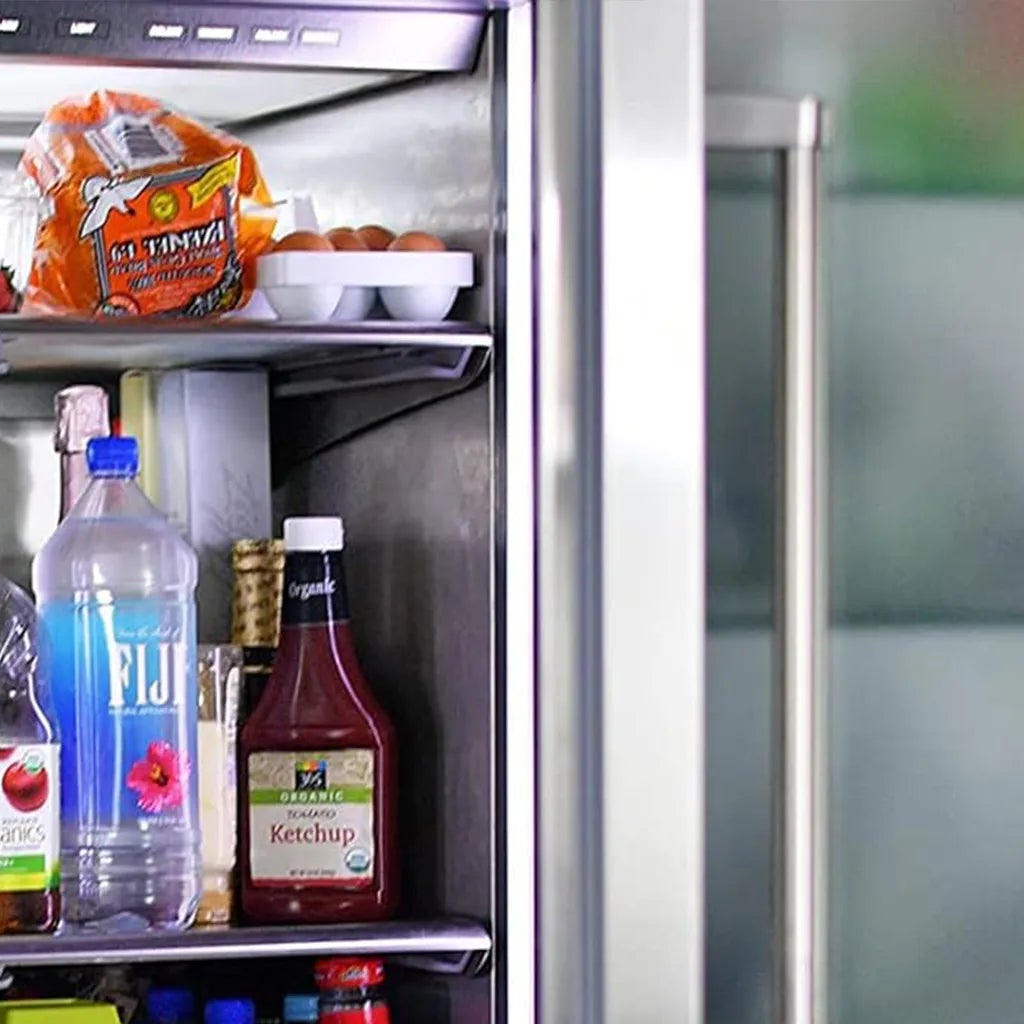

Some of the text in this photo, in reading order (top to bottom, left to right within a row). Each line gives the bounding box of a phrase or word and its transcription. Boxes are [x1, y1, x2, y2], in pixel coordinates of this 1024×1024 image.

[288, 577, 336, 600] Organic
[108, 643, 186, 706] FIJI
[279, 790, 345, 804] ORGANIC
[270, 821, 356, 848] Ketchup
